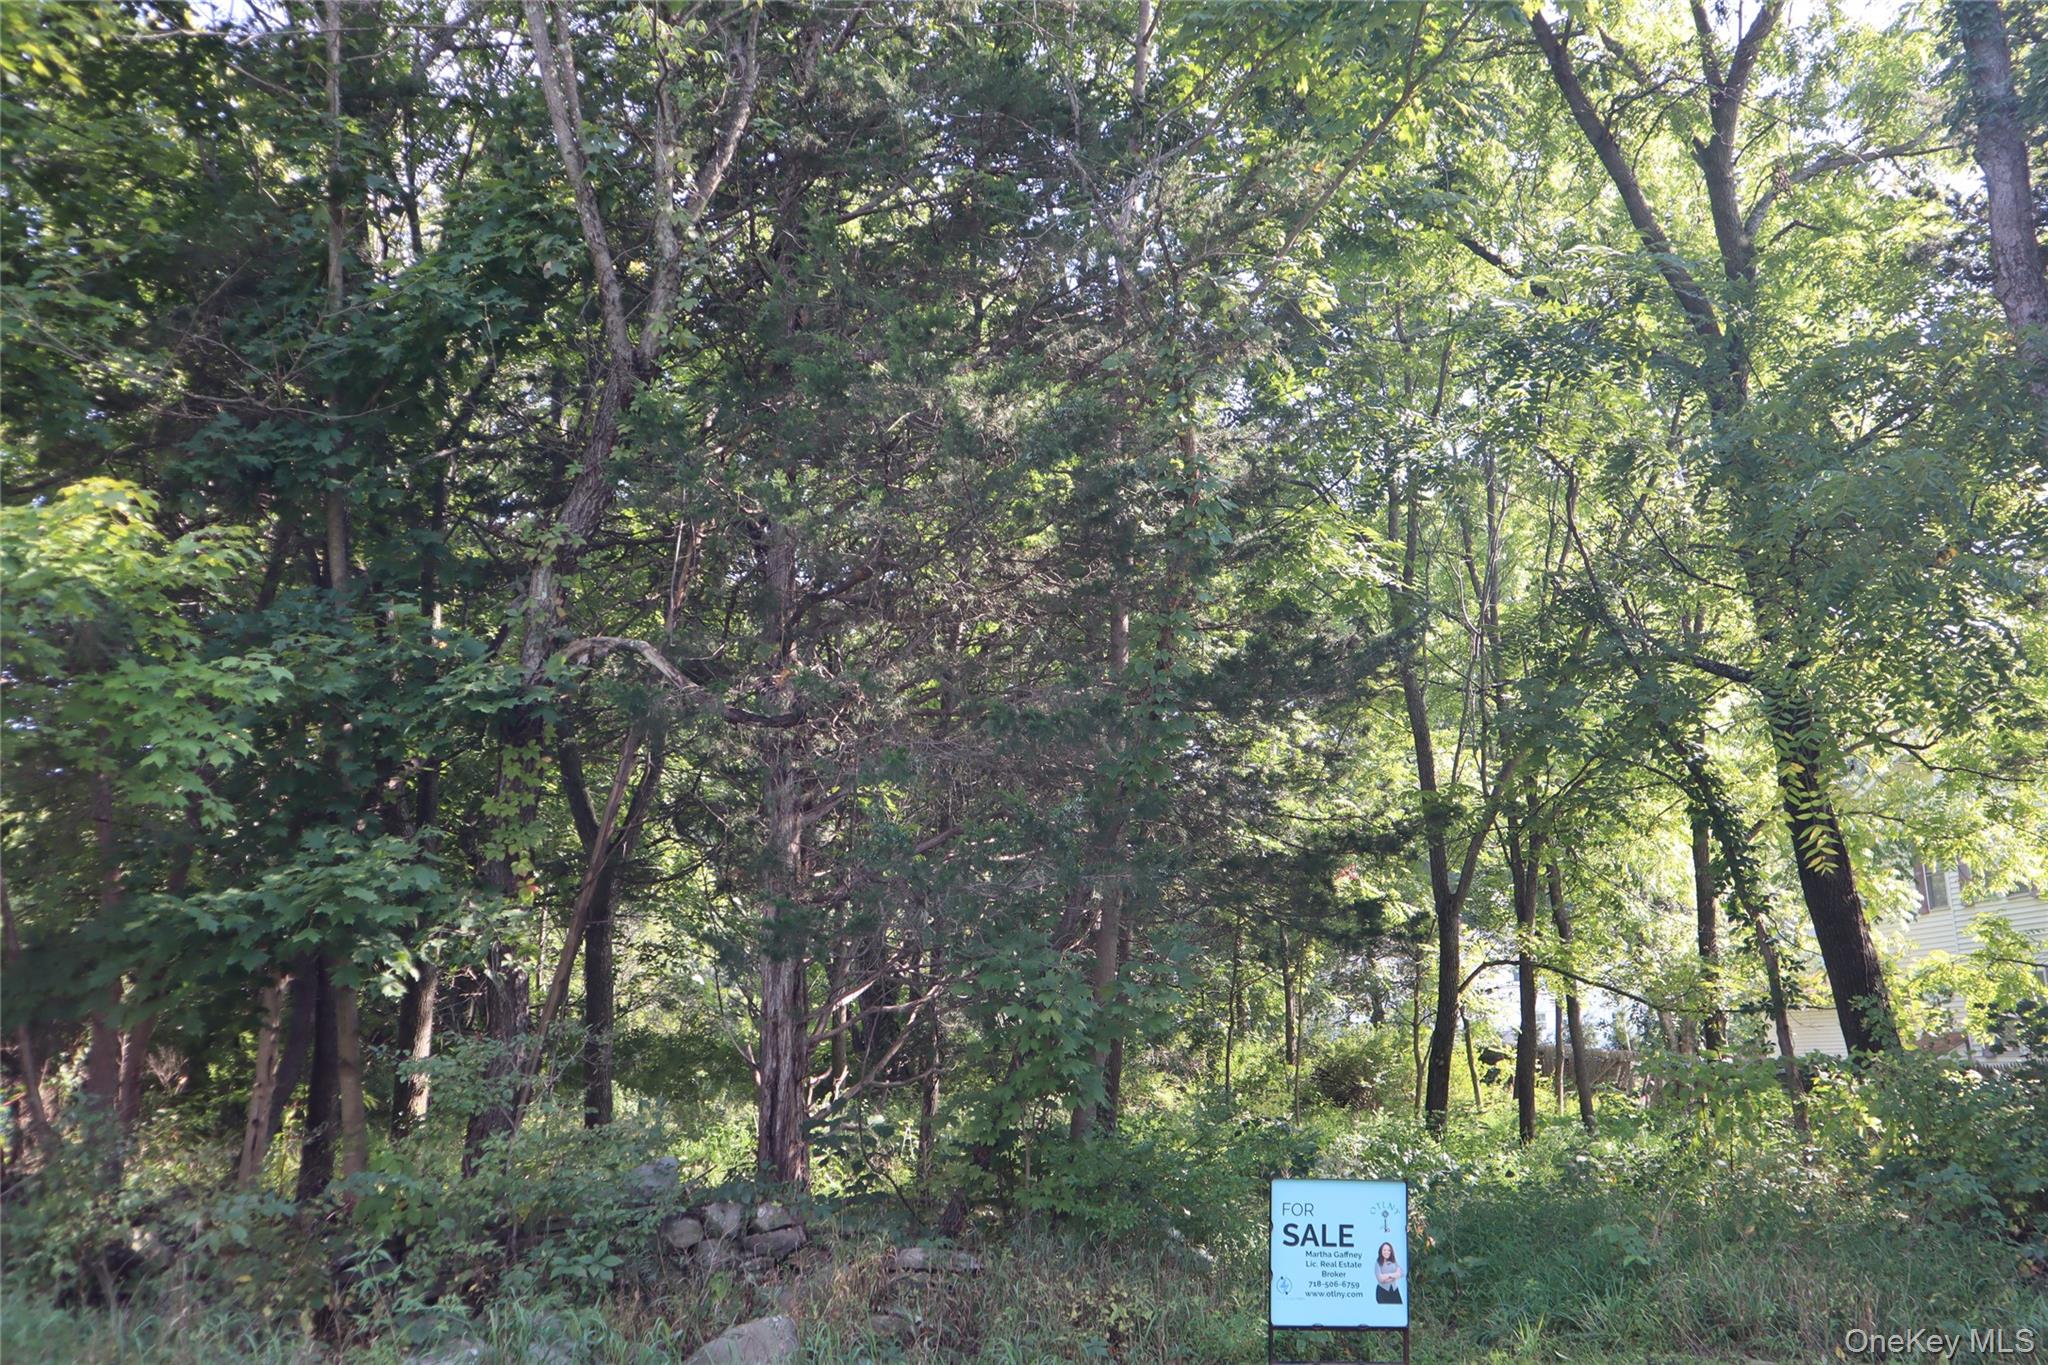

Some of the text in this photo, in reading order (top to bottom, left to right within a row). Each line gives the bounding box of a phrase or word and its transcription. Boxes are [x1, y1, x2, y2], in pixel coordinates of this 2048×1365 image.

[1282, 1202, 1314, 1217] FOR
[1282, 1223, 1355, 1248] SALE
[1305, 1251, 1363, 1260] Martha Gaffney
[1308, 1281, 1360, 1289] 718-506-6759
[1305, 1291, 1364, 1299] www.otlny.com
